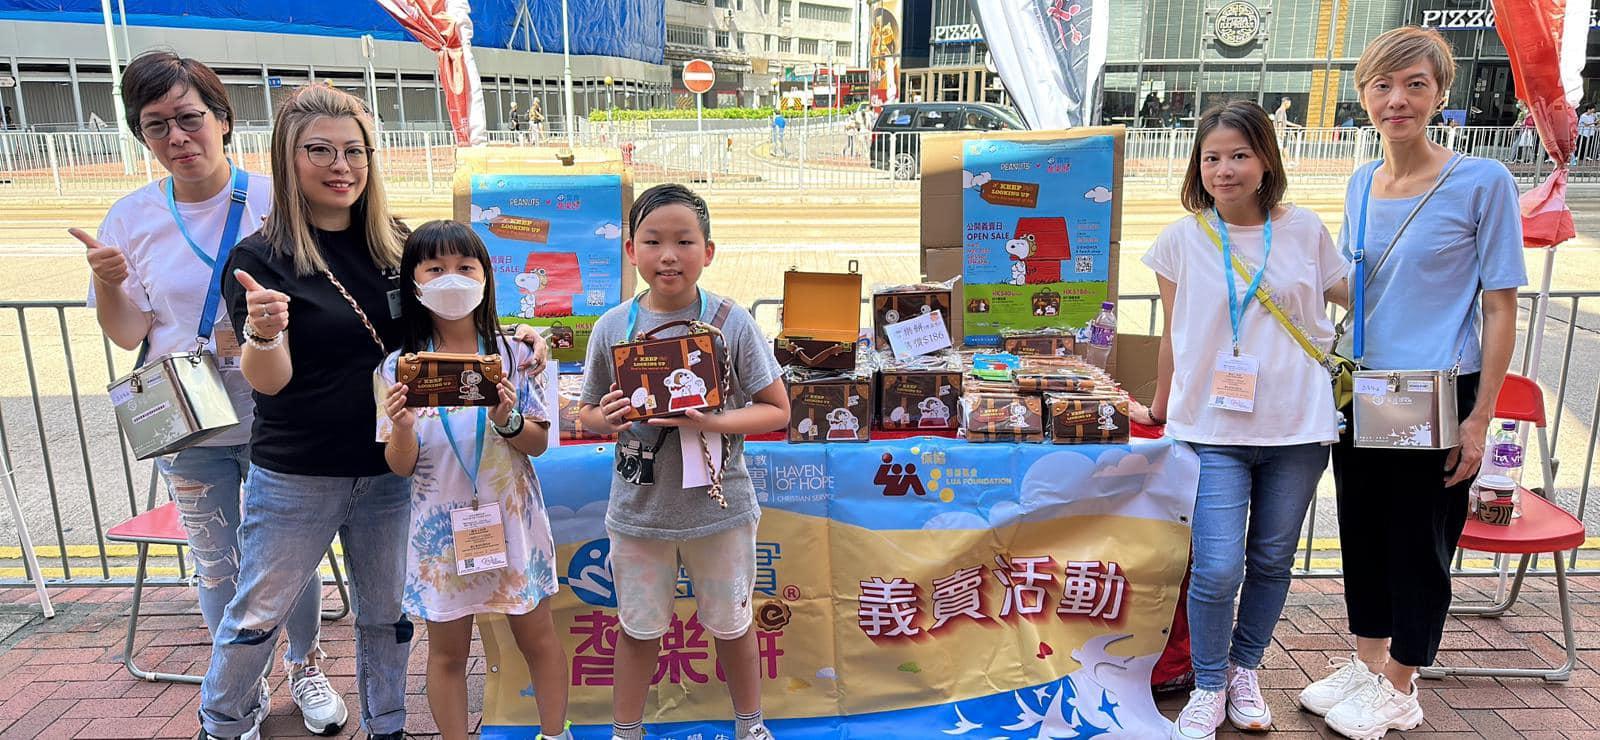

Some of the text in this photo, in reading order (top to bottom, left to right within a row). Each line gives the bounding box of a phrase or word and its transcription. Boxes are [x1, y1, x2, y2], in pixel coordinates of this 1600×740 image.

[936, 24, 983, 41] PIZZA
[1000, 162, 1031, 171] PEANUTS
[509, 198, 540, 206] PEANUTS
[991, 232, 1009, 240] SALE
[775, 464, 824, 479] HAVEN
[776, 475, 835, 490] OF HOPE
[777, 495, 811, 503] CHRISTIAN
[858, 553, 1127, 637] 義賣活動
